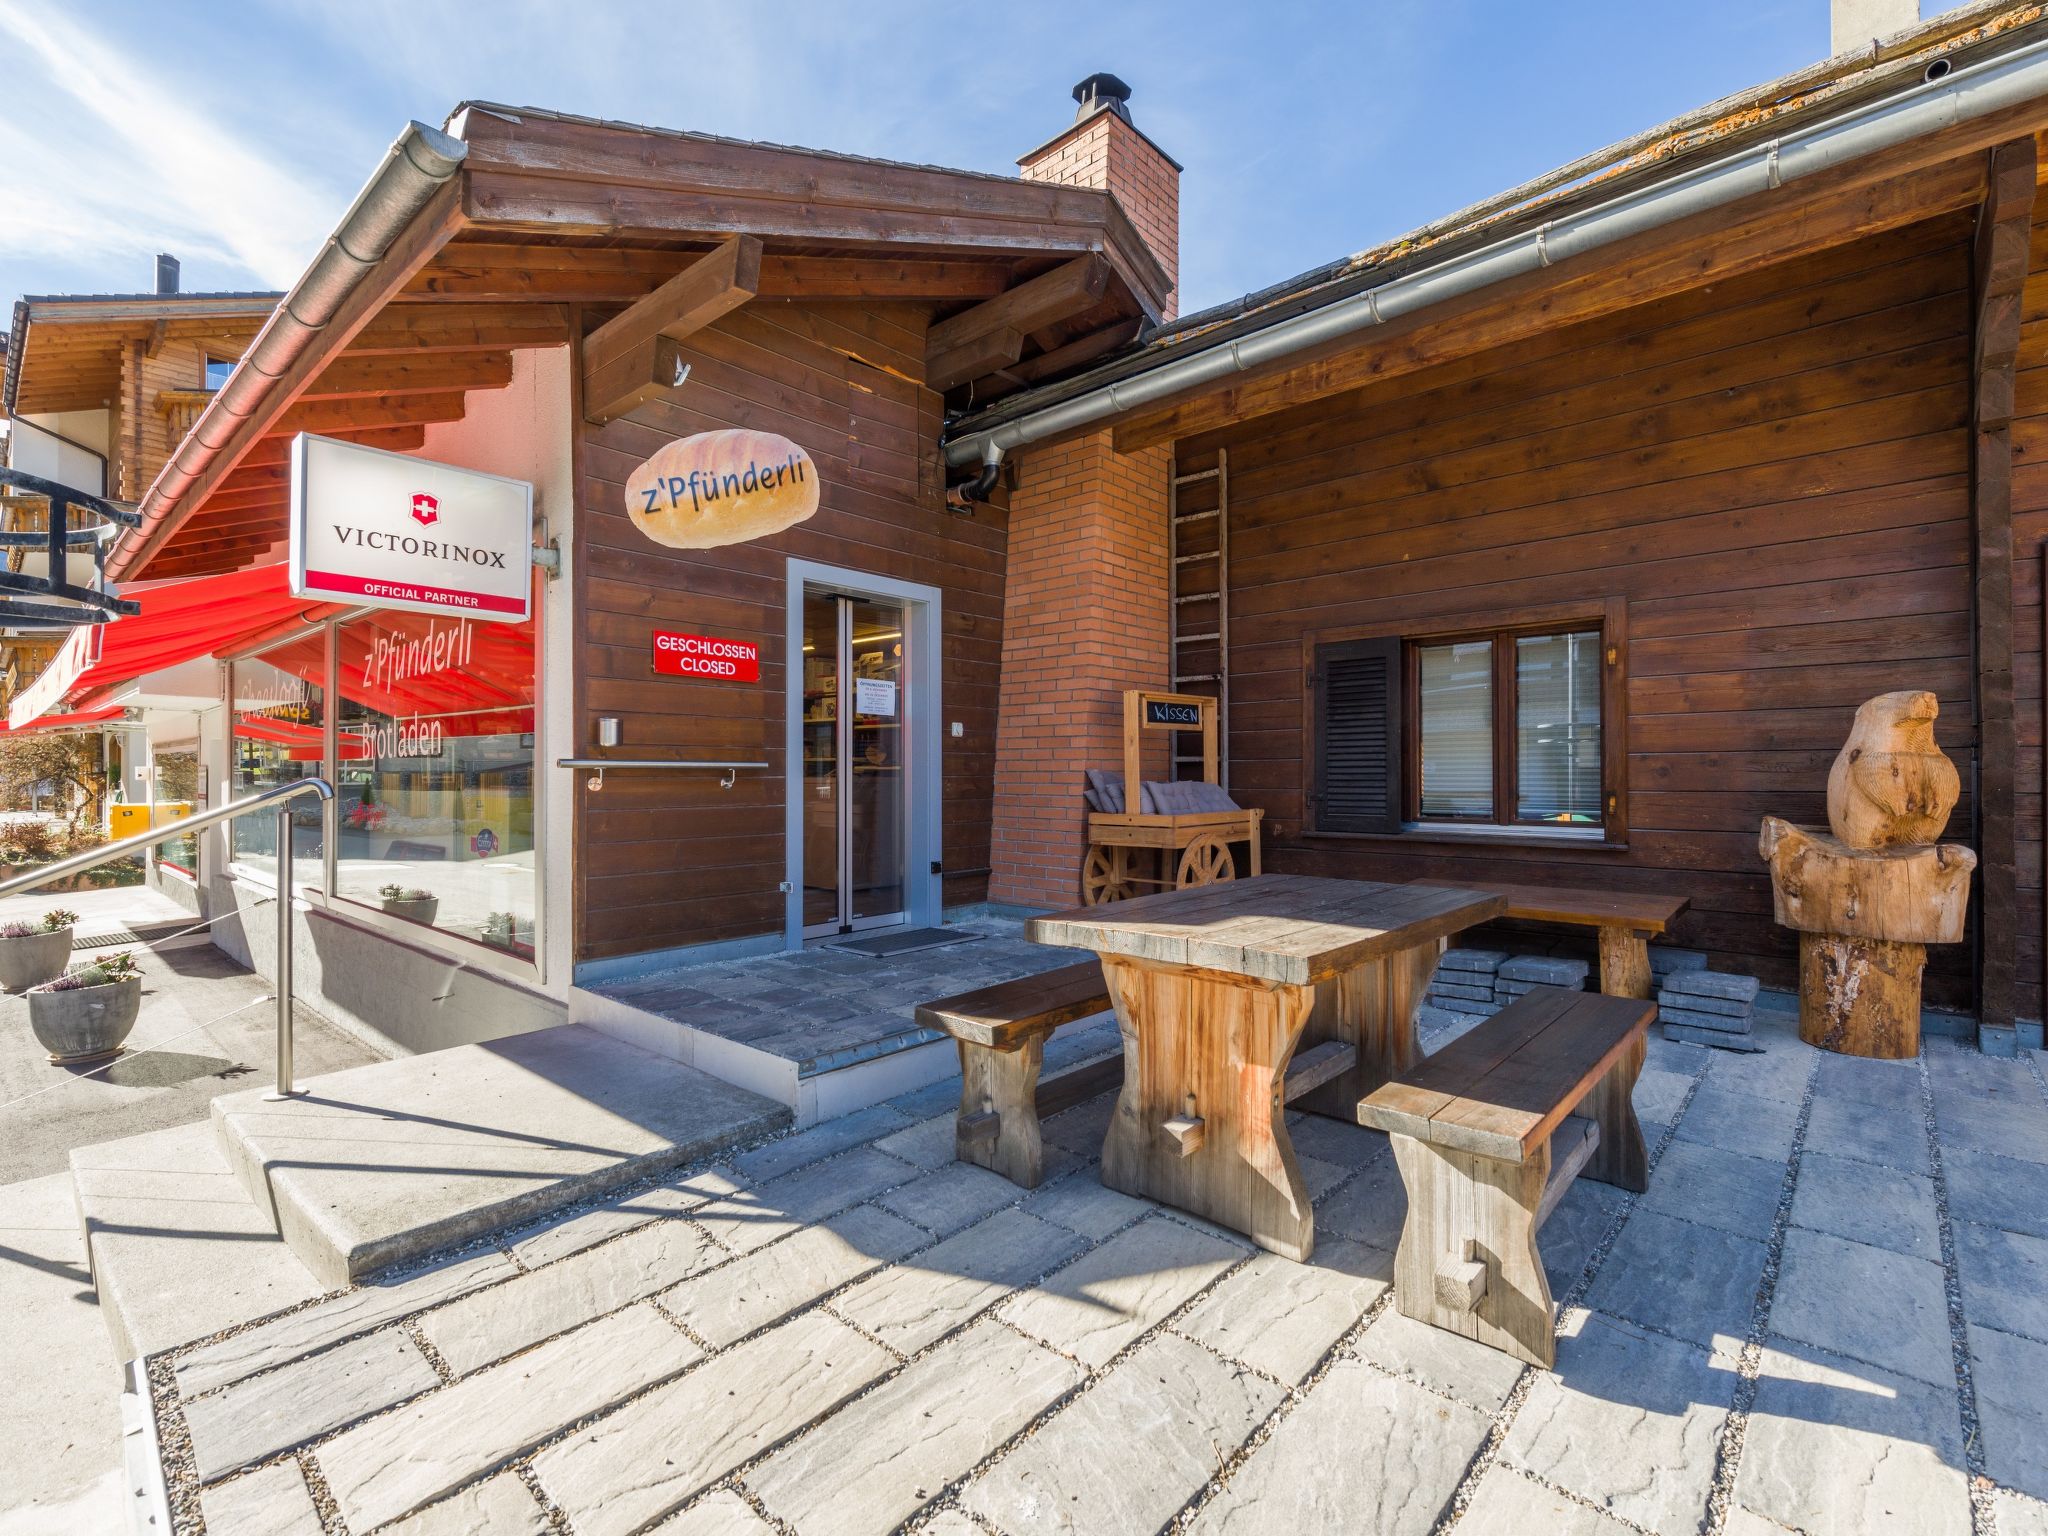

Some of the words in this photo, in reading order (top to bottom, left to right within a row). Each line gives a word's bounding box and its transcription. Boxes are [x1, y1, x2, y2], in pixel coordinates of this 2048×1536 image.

[641, 454, 805, 514] z'Pfünderli
[333, 525, 505, 569] VICTORINOX
[363, 583, 421, 601] OFFICIAL
[424, 591, 479, 608] PARTNER
[656, 635, 756, 661] GESCHLOSSEN
[680, 657, 736, 676] CLOSED
[362, 710, 442, 761] Brotladen
